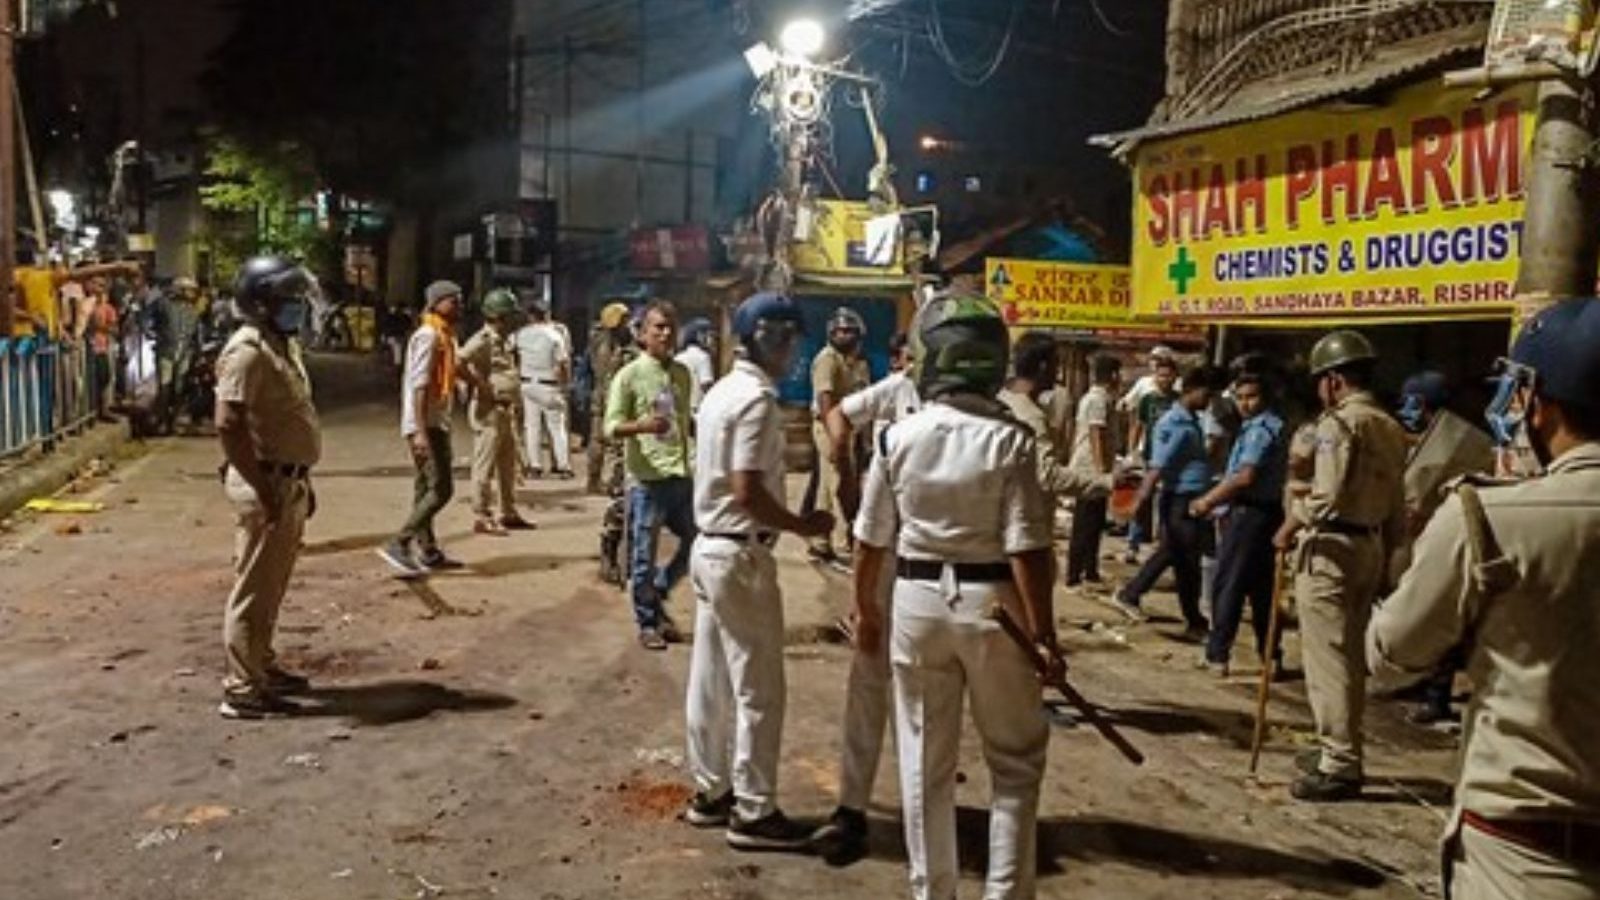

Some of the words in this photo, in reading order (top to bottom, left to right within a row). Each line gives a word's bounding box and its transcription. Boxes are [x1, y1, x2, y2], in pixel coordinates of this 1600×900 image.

[1147, 154, 1267, 247] SHAH
[1287, 98, 1525, 230] PHARM
[1214, 243, 1329, 281] CHEMISTS
[1338, 240, 1356, 272] &
[1367, 221, 1525, 270] DRUGGIST
[1015, 283, 1103, 305] SANKAR
